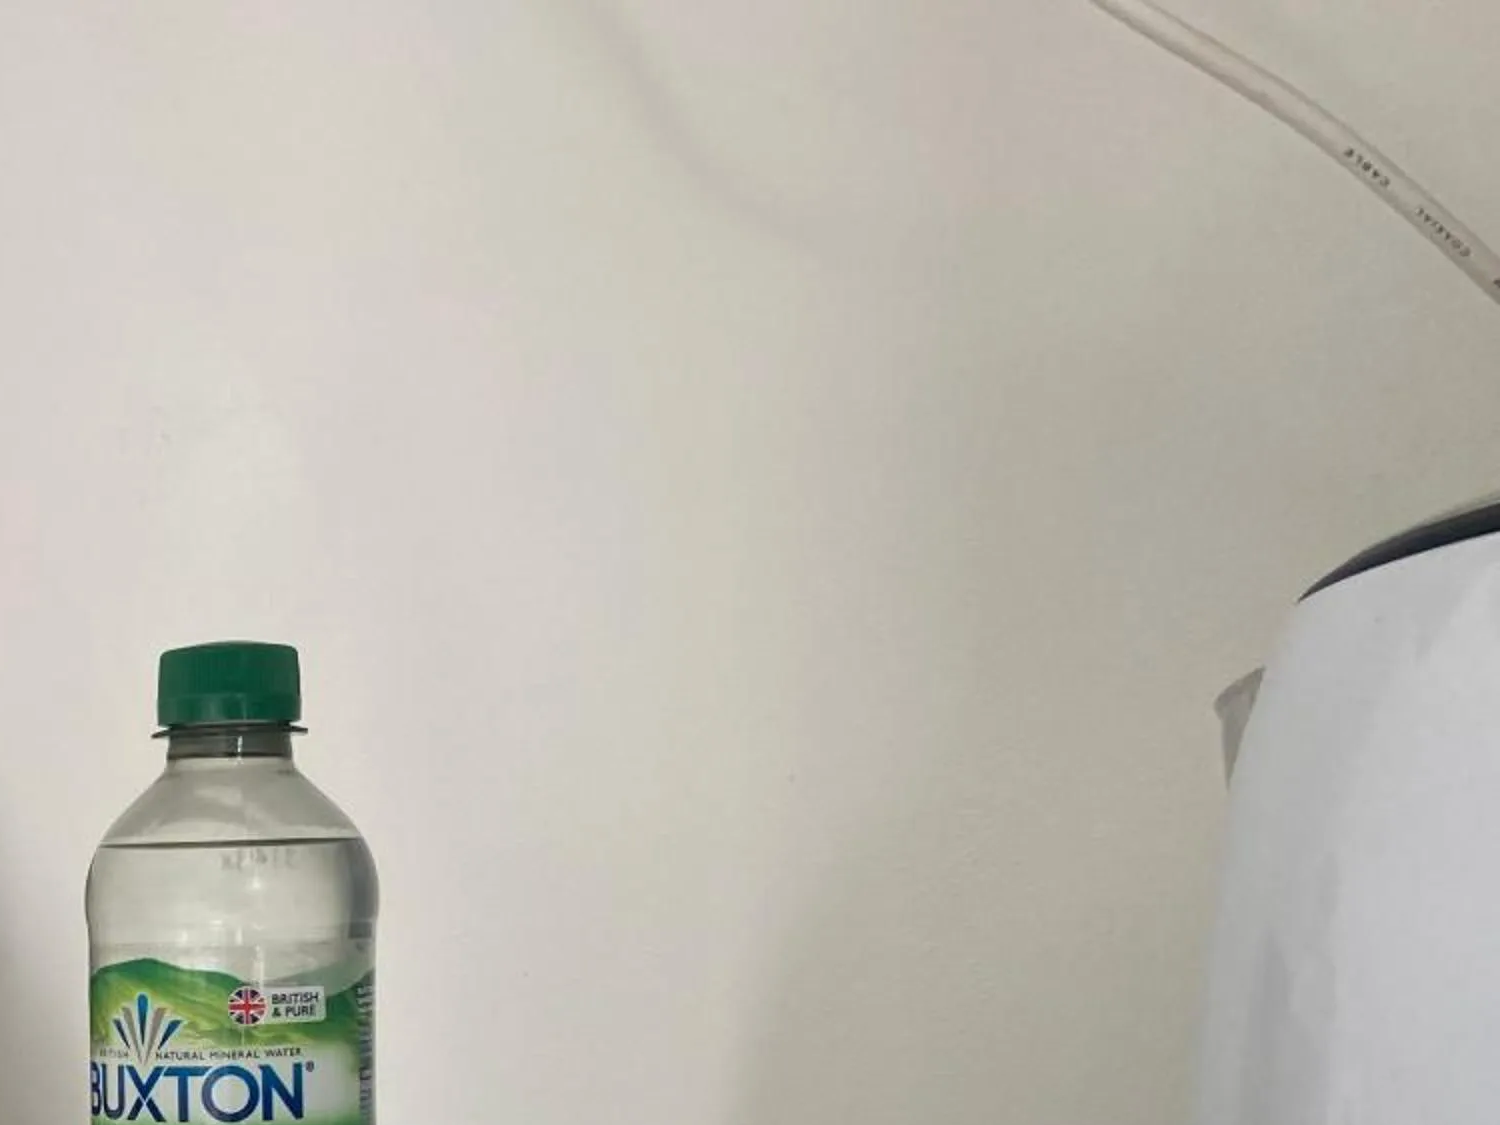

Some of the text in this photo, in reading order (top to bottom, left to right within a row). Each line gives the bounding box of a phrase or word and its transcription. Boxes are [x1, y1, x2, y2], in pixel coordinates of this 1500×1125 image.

[270, 991, 319, 1004] BRITISH
[271, 1004, 316, 1017] & PURE
[155, 1050, 206, 1061] NATURAL
[209, 1050, 260, 1061] MINERAL
[265, 1047, 303, 1058] WATER
[90, 1062, 304, 1123] BUXTON
